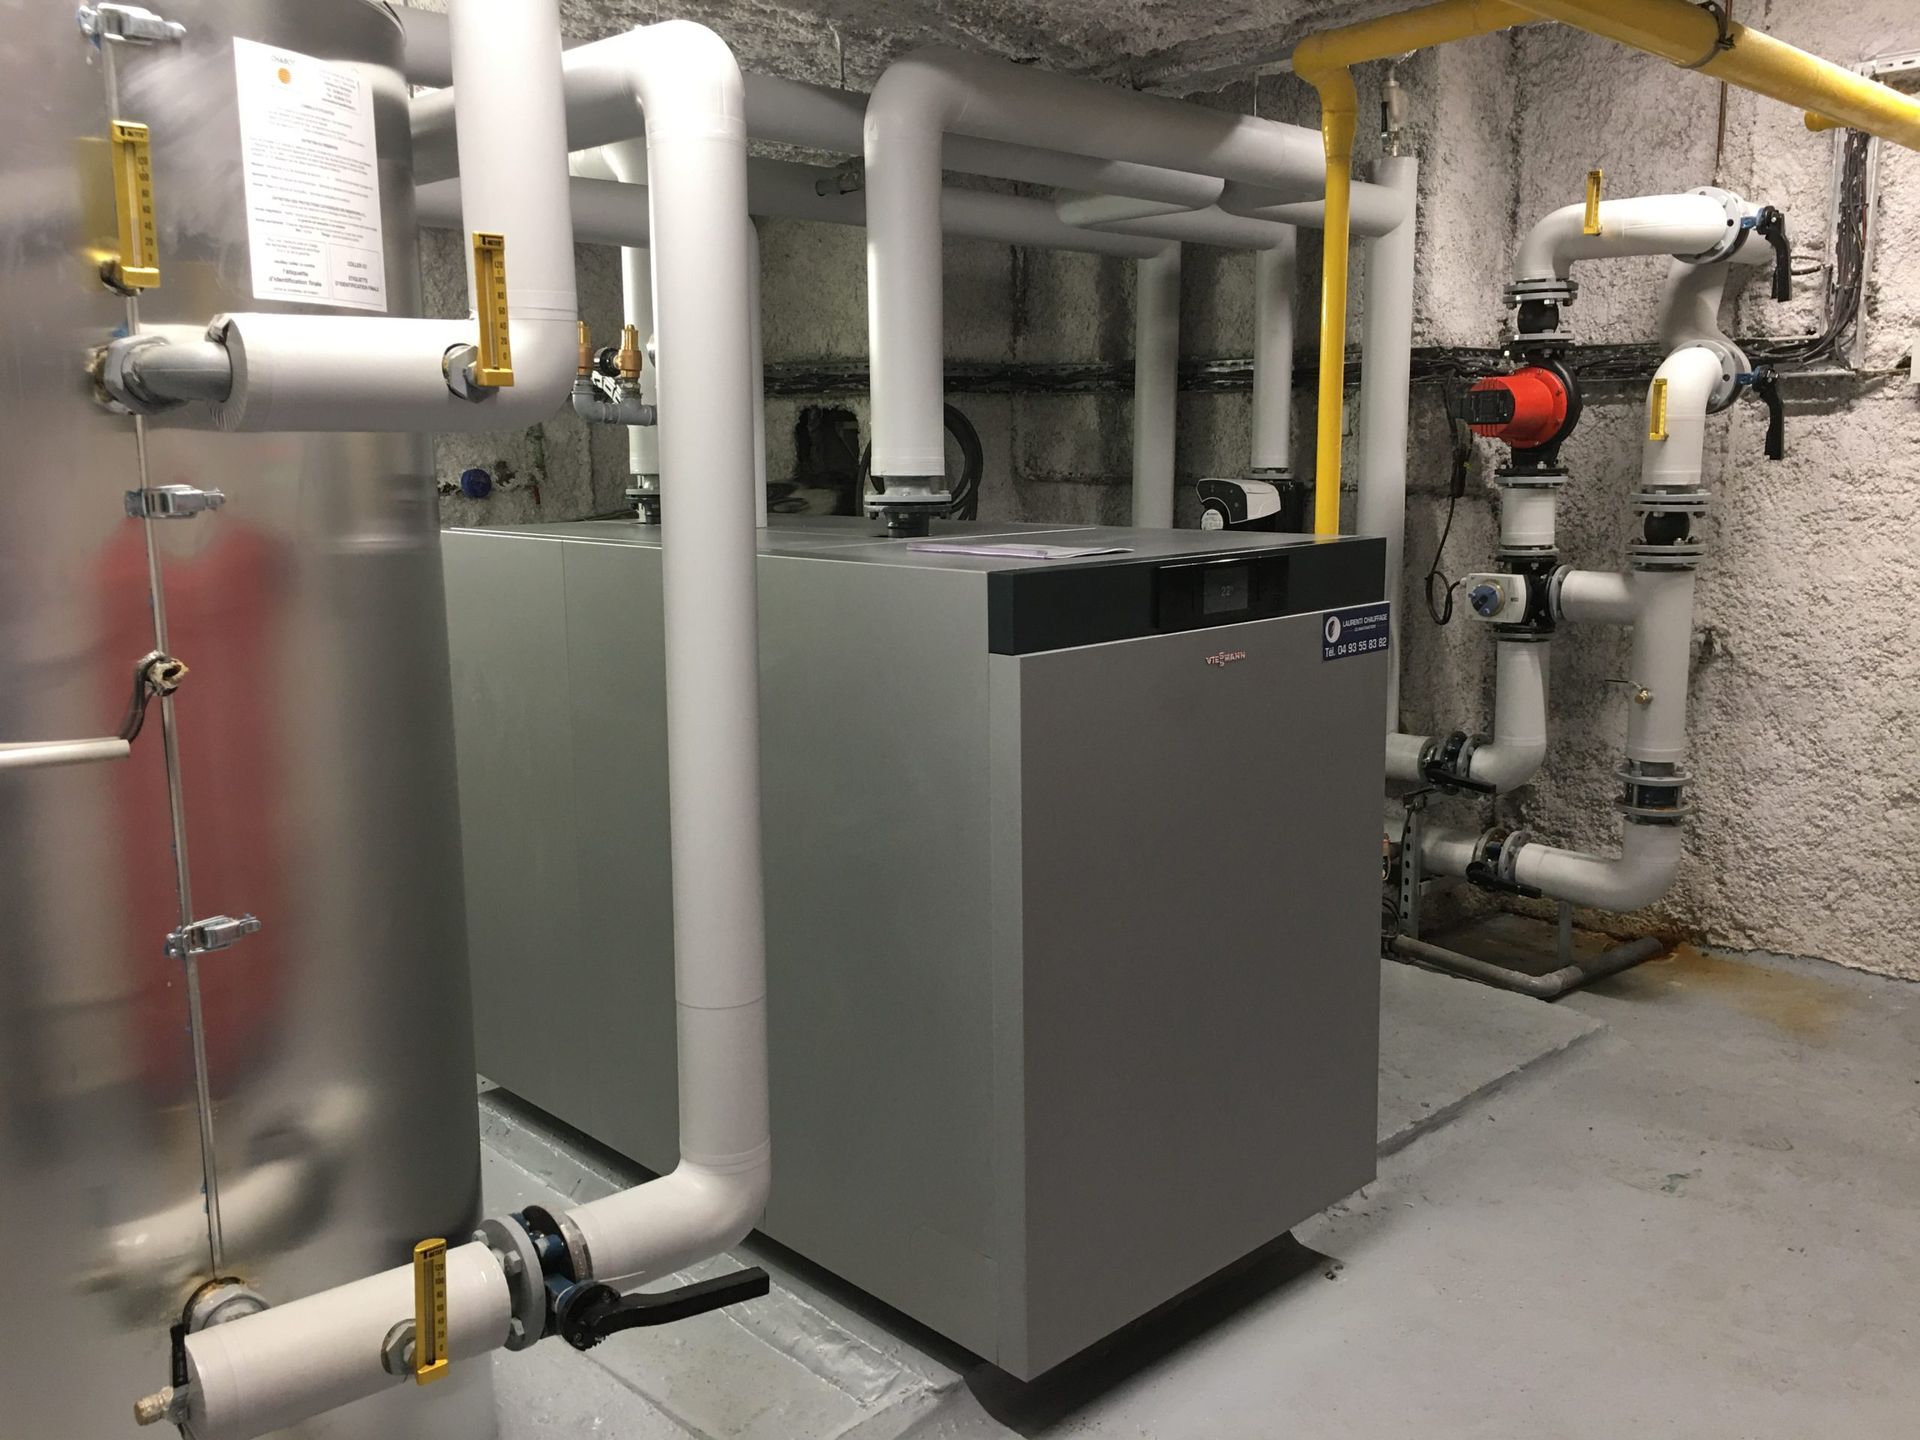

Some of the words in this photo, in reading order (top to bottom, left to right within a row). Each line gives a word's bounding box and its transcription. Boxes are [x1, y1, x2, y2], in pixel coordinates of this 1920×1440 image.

[138, 156, 148, 165] 120
[139, 173, 149, 181] 100
[142, 189, 149, 198] 80
[143, 205, 150, 214] 60
[144, 222, 152, 230] 40
[145, 237, 153, 246] 20
[494, 261, 503, 269] 120
[495, 276, 504, 284] 100
[497, 291, 504, 300] 80
[498, 306, 505, 315] 60
[500, 322, 507, 330] 40
[500, 337, 507, 345] 20
[1364, 613, 1388, 624] CHAUFFAGE
[1338, 644, 1346, 655] 04
[1348, 642, 1357, 653] 93
[1359, 640, 1367, 651] 55
[1369, 639, 1377, 649] 83
[1379, 637, 1387, 648] 82
